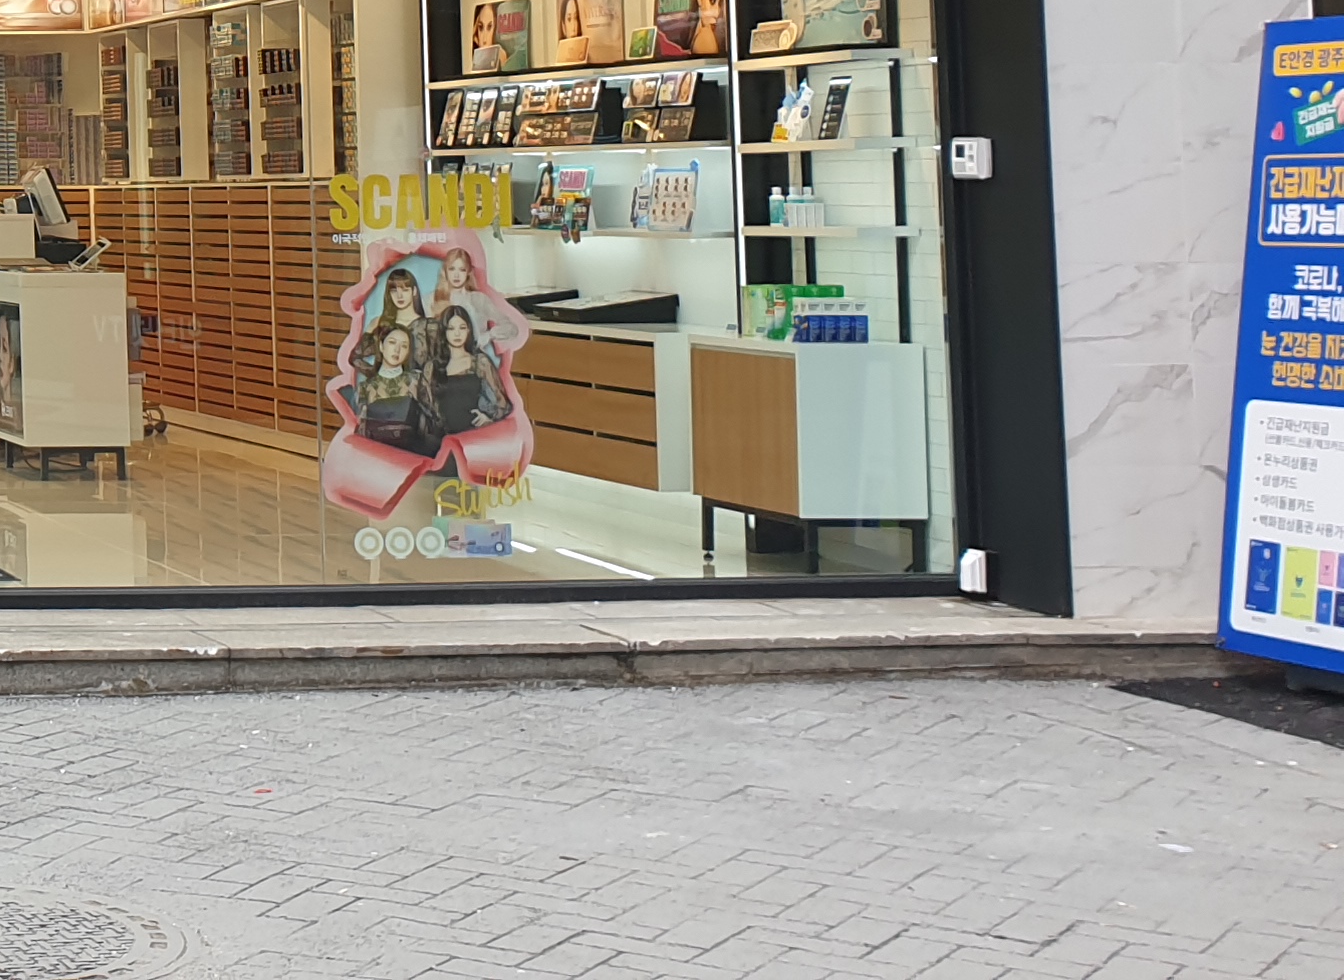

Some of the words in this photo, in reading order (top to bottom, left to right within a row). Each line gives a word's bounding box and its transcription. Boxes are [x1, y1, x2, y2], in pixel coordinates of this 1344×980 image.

[1278, 51, 1314, 70] E안경
[328, 174, 512, 230] SCANDI
[1267, 294, 1301, 320] 함께
[1260, 330, 1276, 357] 눈
[1279, 331, 1323, 358] 건강을
[1272, 361, 1316, 388] 현명한
[434, 461, 533, 520] Stylish
